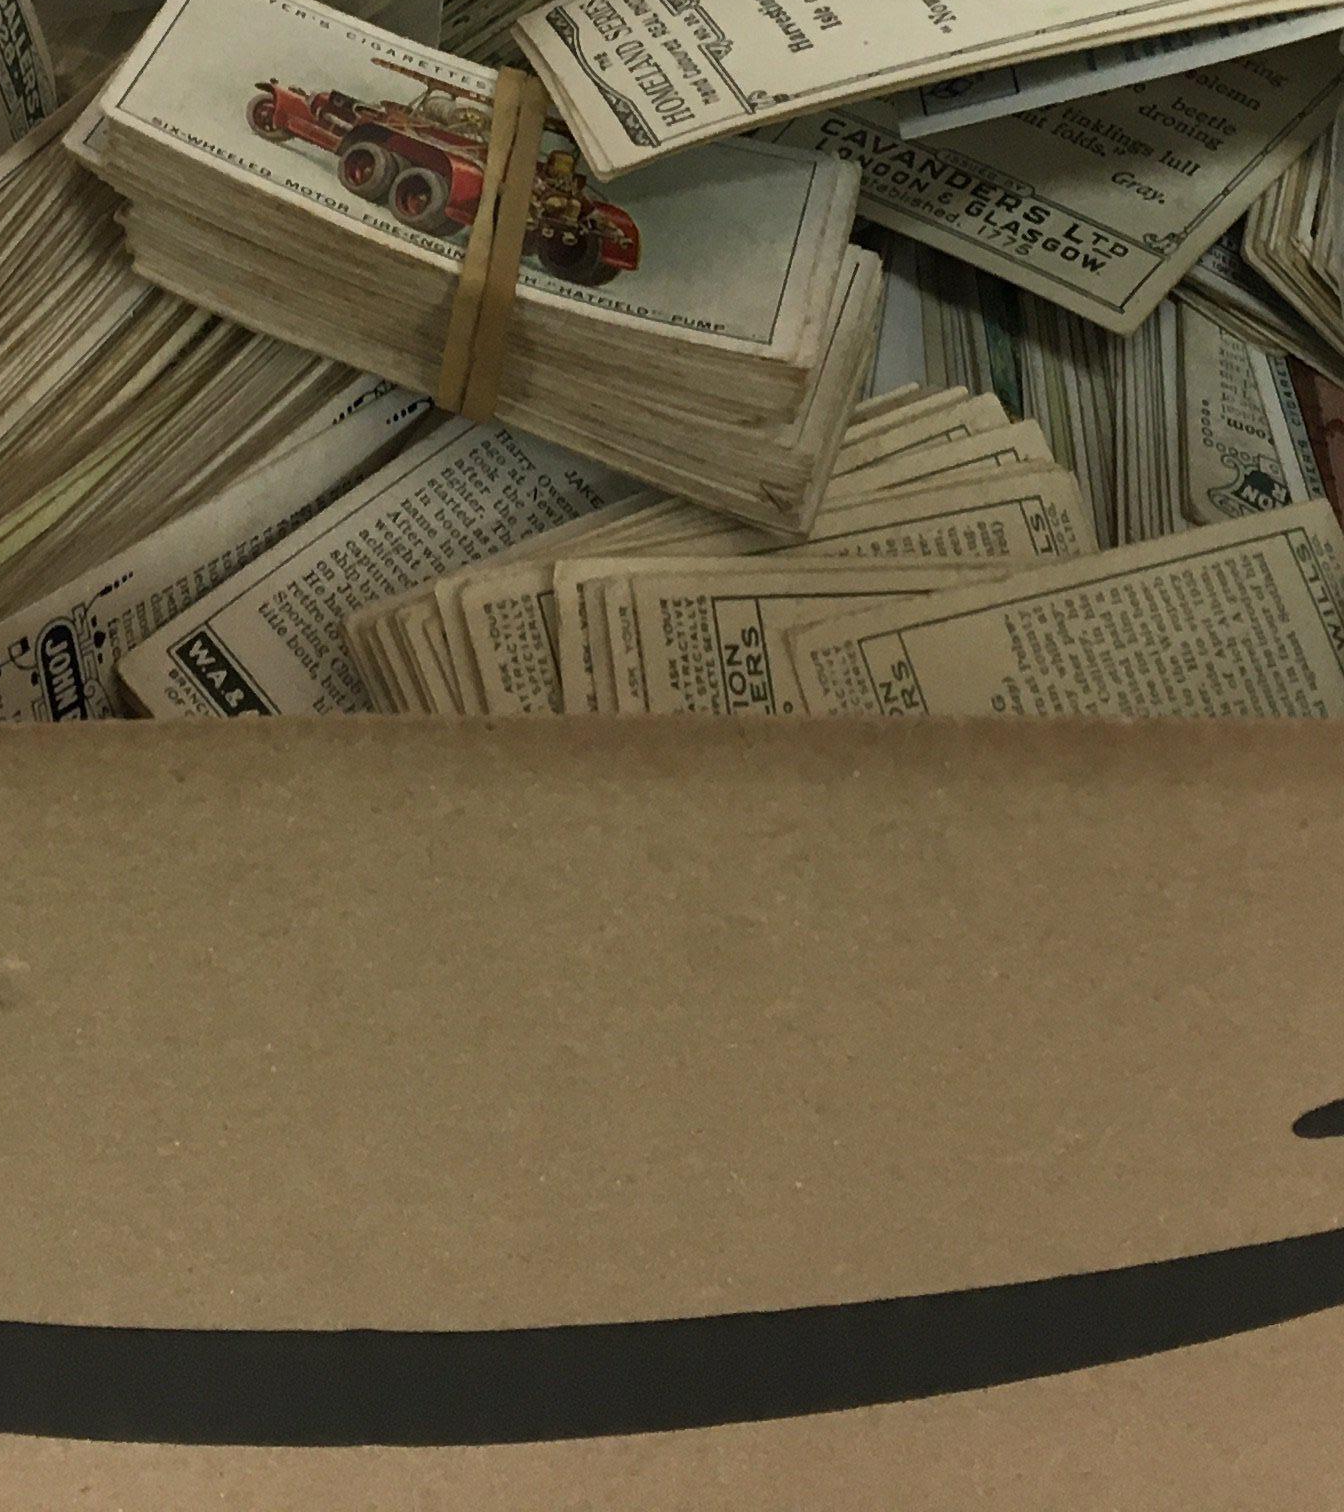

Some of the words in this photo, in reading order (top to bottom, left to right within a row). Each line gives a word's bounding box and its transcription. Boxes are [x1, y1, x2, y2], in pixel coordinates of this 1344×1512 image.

[808, 1, 842, 36] Isle
[613, 32, 696, 133] HOMELAND
[1061, 100, 1157, 161] tinklings
[1157, 147, 1202, 181] lull
[1136, 98, 1224, 153] droning
[1169, 92, 1239, 139] beetle
[150, 114, 272, 180] SIX-WHEELED
[284, 176, 350, 214] MOTOR
[814, 133, 930, 198] LONDON
[818, 113, 1053, 231] CAVANDERS
[1109, 165, 1169, 208] Gray.
[975, 221, 1033, 260] 1775
[670, 313, 726, 333] PUMP
[464, 445, 504, 482] took
[499, 481, 531, 511] the
[476, 438, 508, 468] ago
[505, 465, 528, 487] at
[493, 426, 540, 475] Harry
[422, 474, 478, 529] started
[470, 525, 493, 547] as
[434, 464, 495, 519] fighter.
[449, 455, 495, 497] after
[489, 495, 521, 526] the
[559, 466, 607, 510] JAKE
[367, 518, 424, 573] weight
[380, 505, 429, 550] After
[396, 495, 441, 540] name
[437, 537, 459, 559] in
[411, 485, 434, 506] in
[431, 506, 487, 563] booths
[300, 568, 329, 596] He
[312, 557, 338, 582] on
[323, 545, 366, 585] ship
[354, 527, 420, 593] achieved
[269, 588, 333, 658] Sporting
[285, 579, 327, 624] retire
[321, 618, 345, 642] to
[42, 636, 78, 712] JOHN
[253, 599, 293, 638] title
[282, 632, 326, 673] bout,
[318, 674, 348, 707] but
